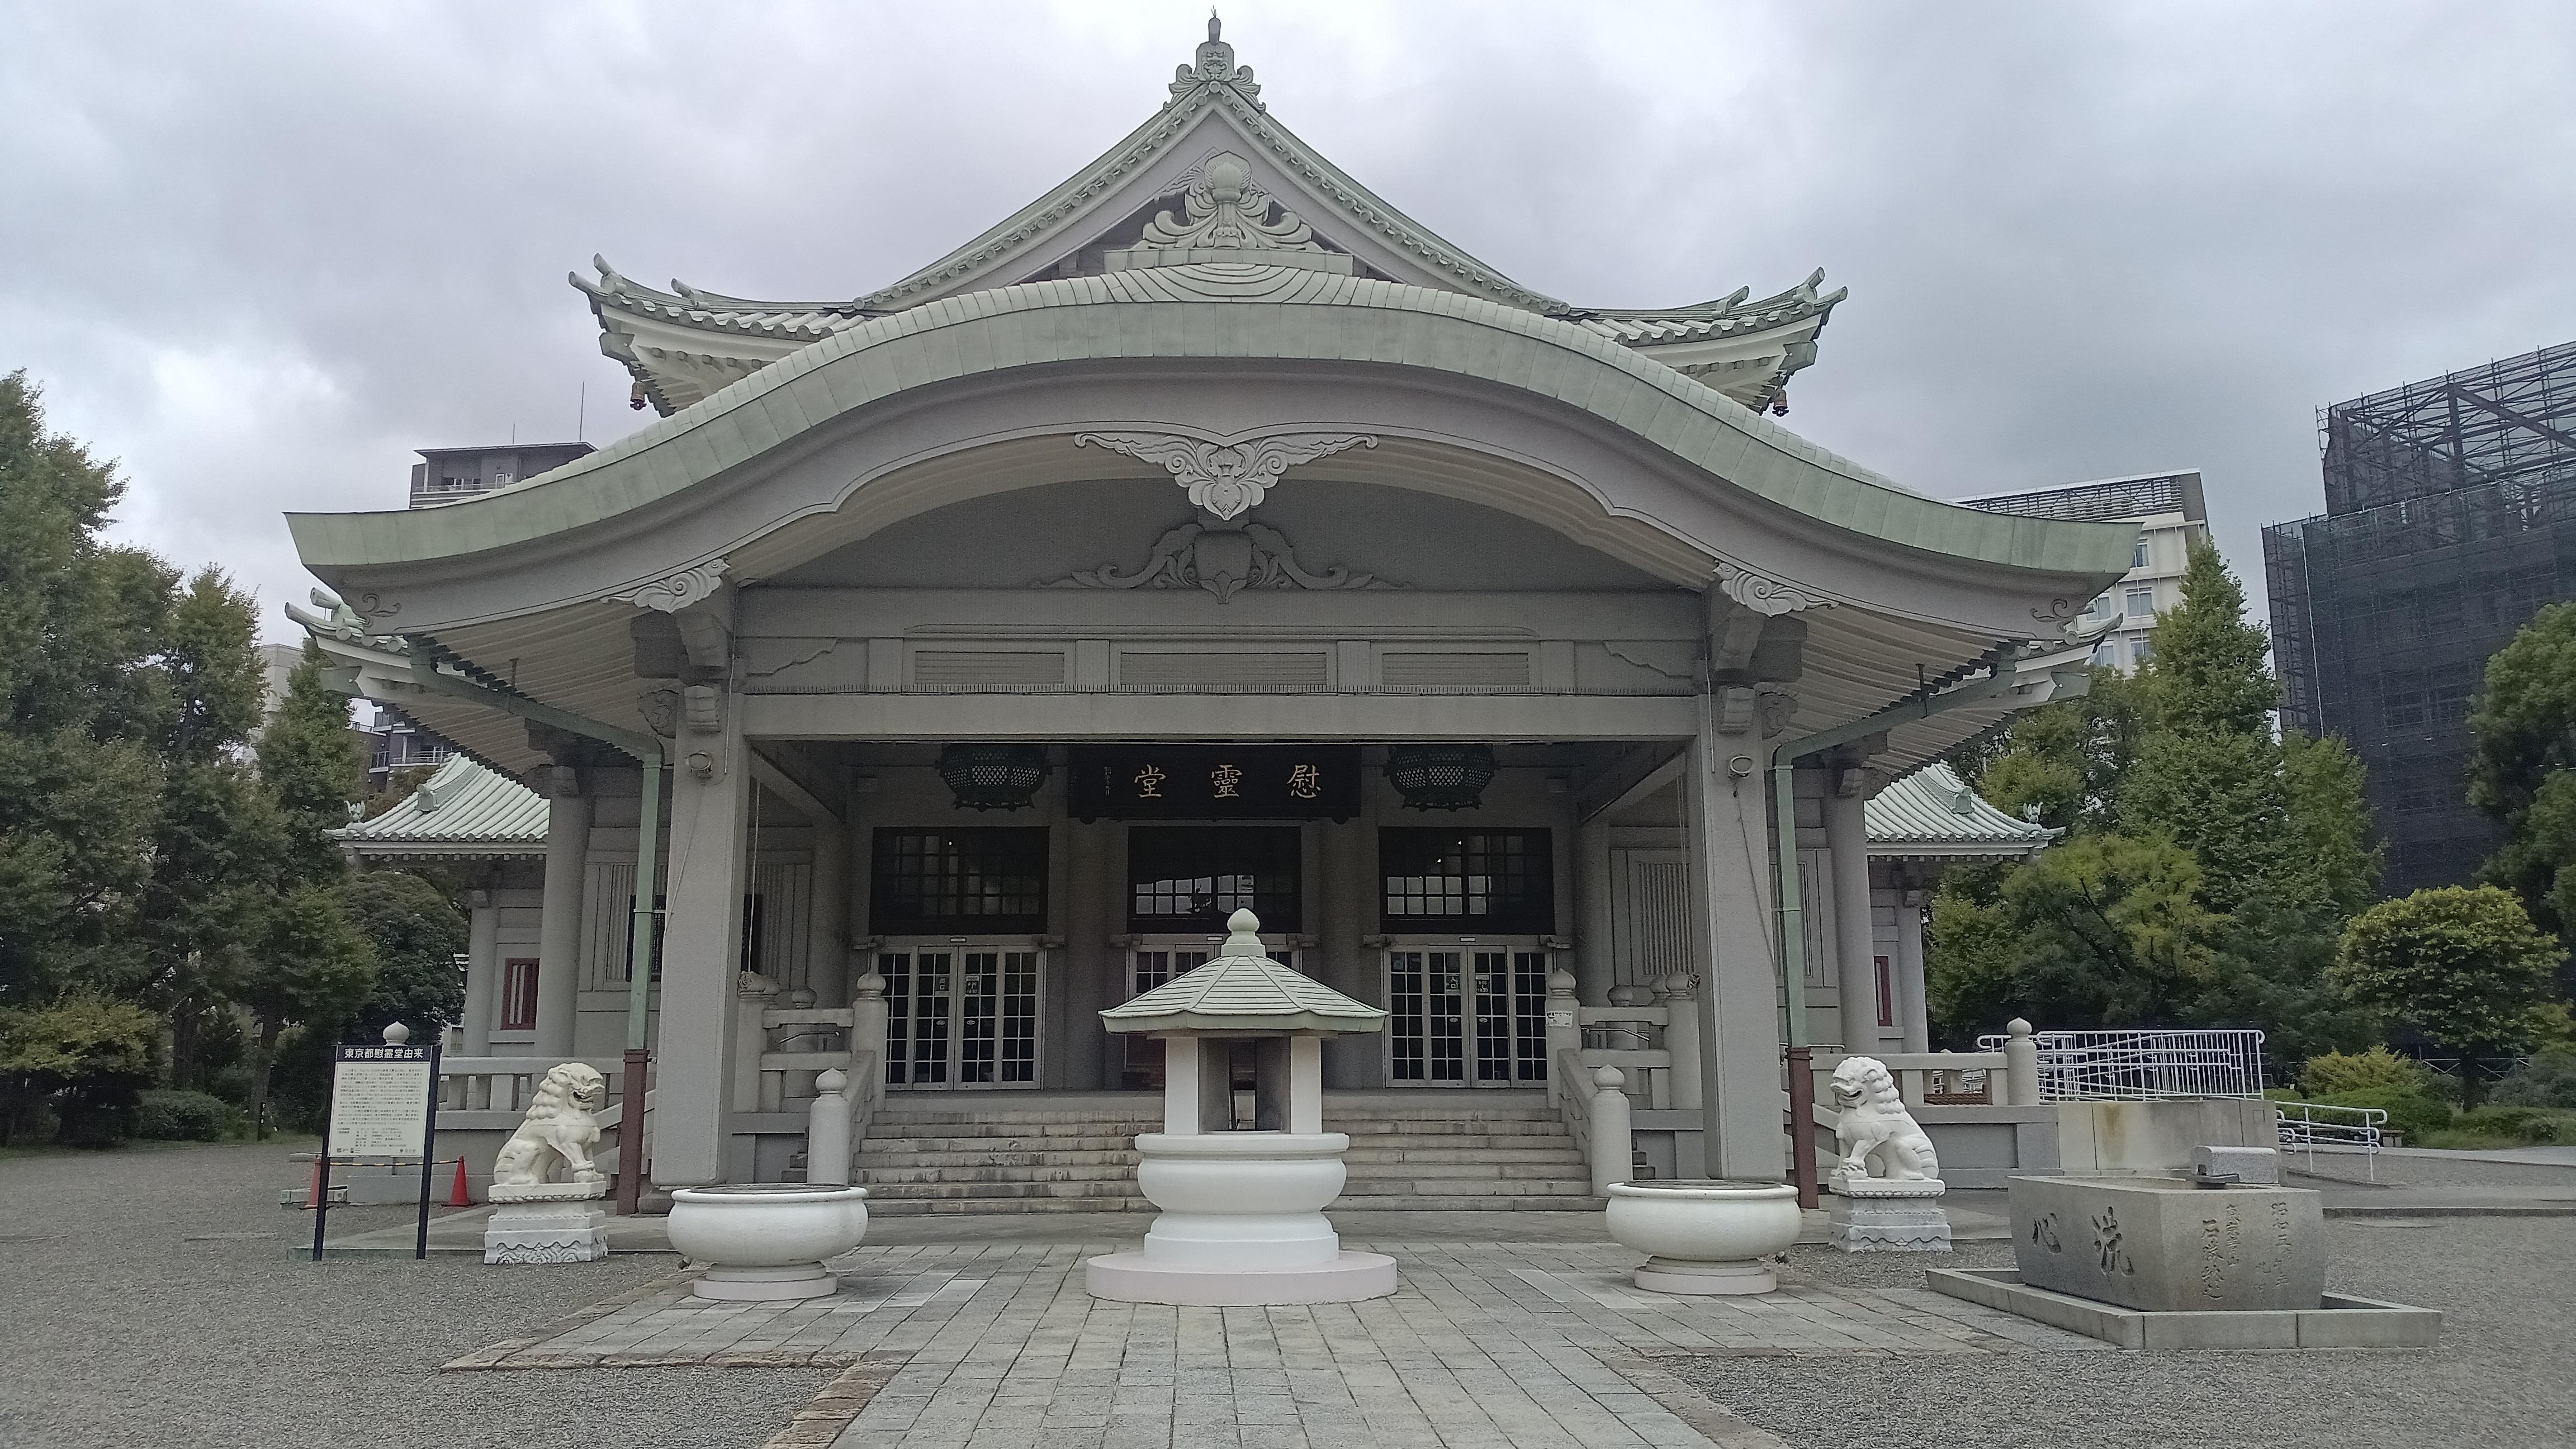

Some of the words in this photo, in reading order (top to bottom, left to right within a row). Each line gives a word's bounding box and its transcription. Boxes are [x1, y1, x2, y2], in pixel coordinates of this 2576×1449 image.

[1134, 763, 1321, 799] 慰靈堂
[344, 1048, 424, 1059] 東京都慰霊堂由来
